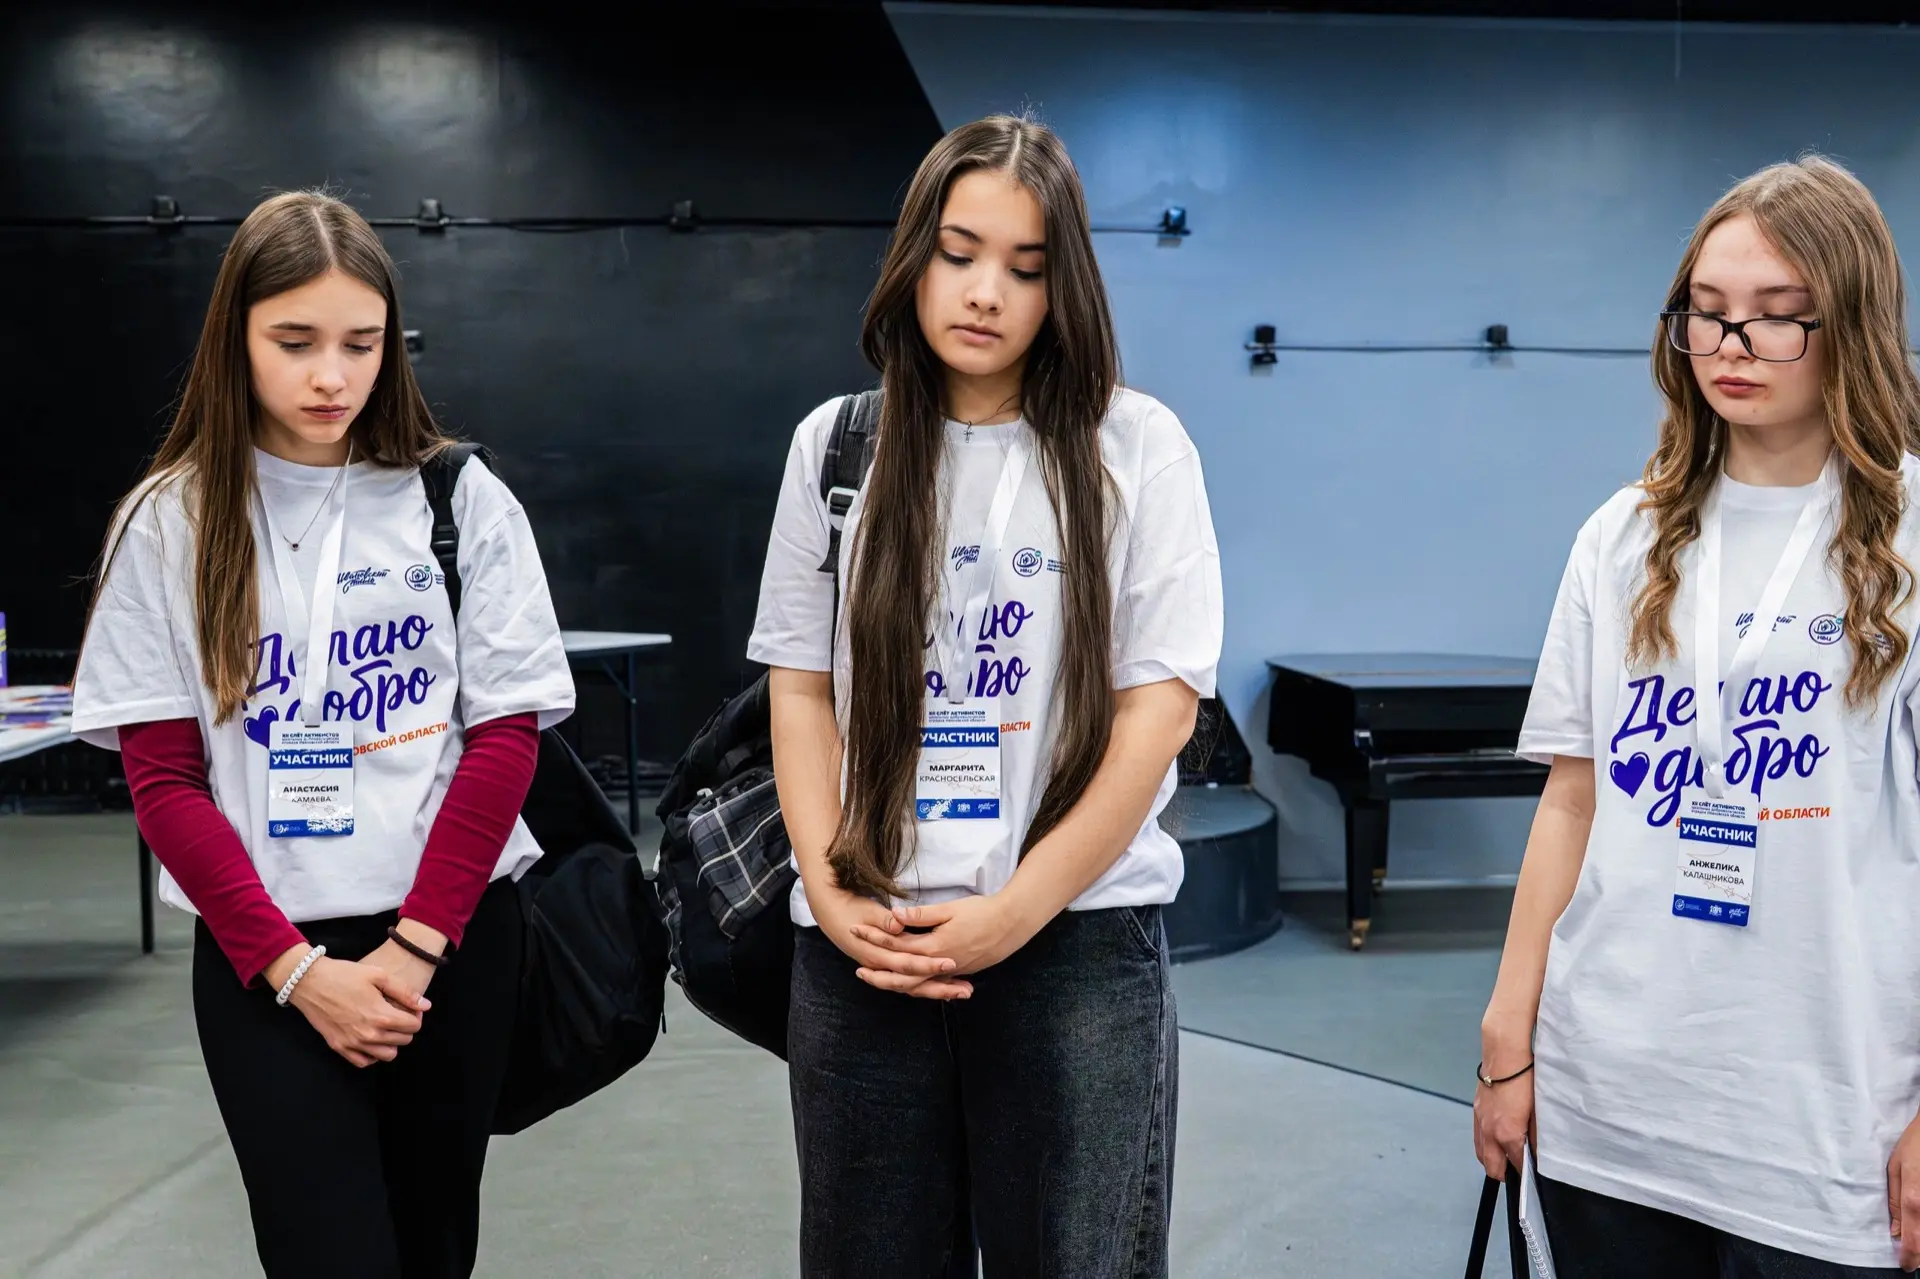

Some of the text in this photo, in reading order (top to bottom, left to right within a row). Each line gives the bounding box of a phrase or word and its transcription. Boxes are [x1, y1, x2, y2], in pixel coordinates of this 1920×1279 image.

[241, 614, 434, 711] Длаю
[1610, 670, 1833, 754] Деаю
[398, 722, 448, 743] ОБЛАСТИ
[1000, 721, 1031, 733] БЛАСТИ
[920, 732, 996, 743] УЧАСТНИК
[272, 753, 349, 765] УЧАСТНИК
[929, 764, 985, 772] МАРГАРИТА
[919, 775, 995, 783] КРАСНОСЕЛЬСКАЯ
[283, 785, 339, 793] АНАСТАСИЯ
[1712, 803, 1745, 811] АКТИВИСТОВ
[1773, 806, 1831, 820] ОБЛАСТИ
[1682, 823, 1754, 843] УЧАСТНИК
[1689, 859, 1740, 873] АНЖЕЛИКА
[1683, 870, 1745, 886] КАЛАШНИКОВА
